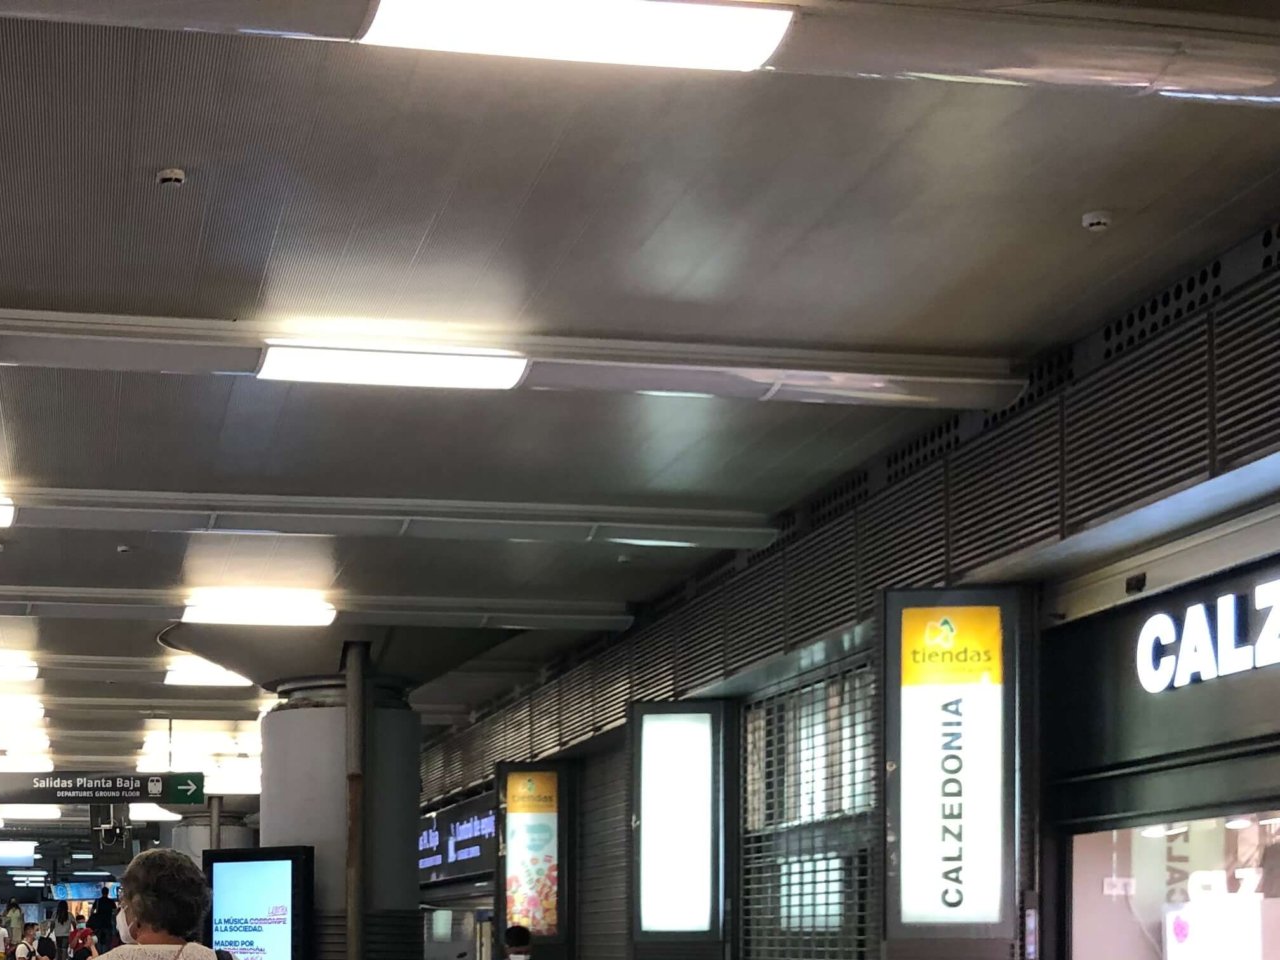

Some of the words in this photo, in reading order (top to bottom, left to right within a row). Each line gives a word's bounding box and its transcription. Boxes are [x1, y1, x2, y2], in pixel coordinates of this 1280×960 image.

[911, 648, 992, 664] tiendas
[1137, 580, 1280, 693] CALZ
[33, 777, 73, 788] Salidas
[76, 777, 113, 788] Planta
[116, 777, 141, 790] Baja
[941, 698, 963, 908] CALZEDONIA
